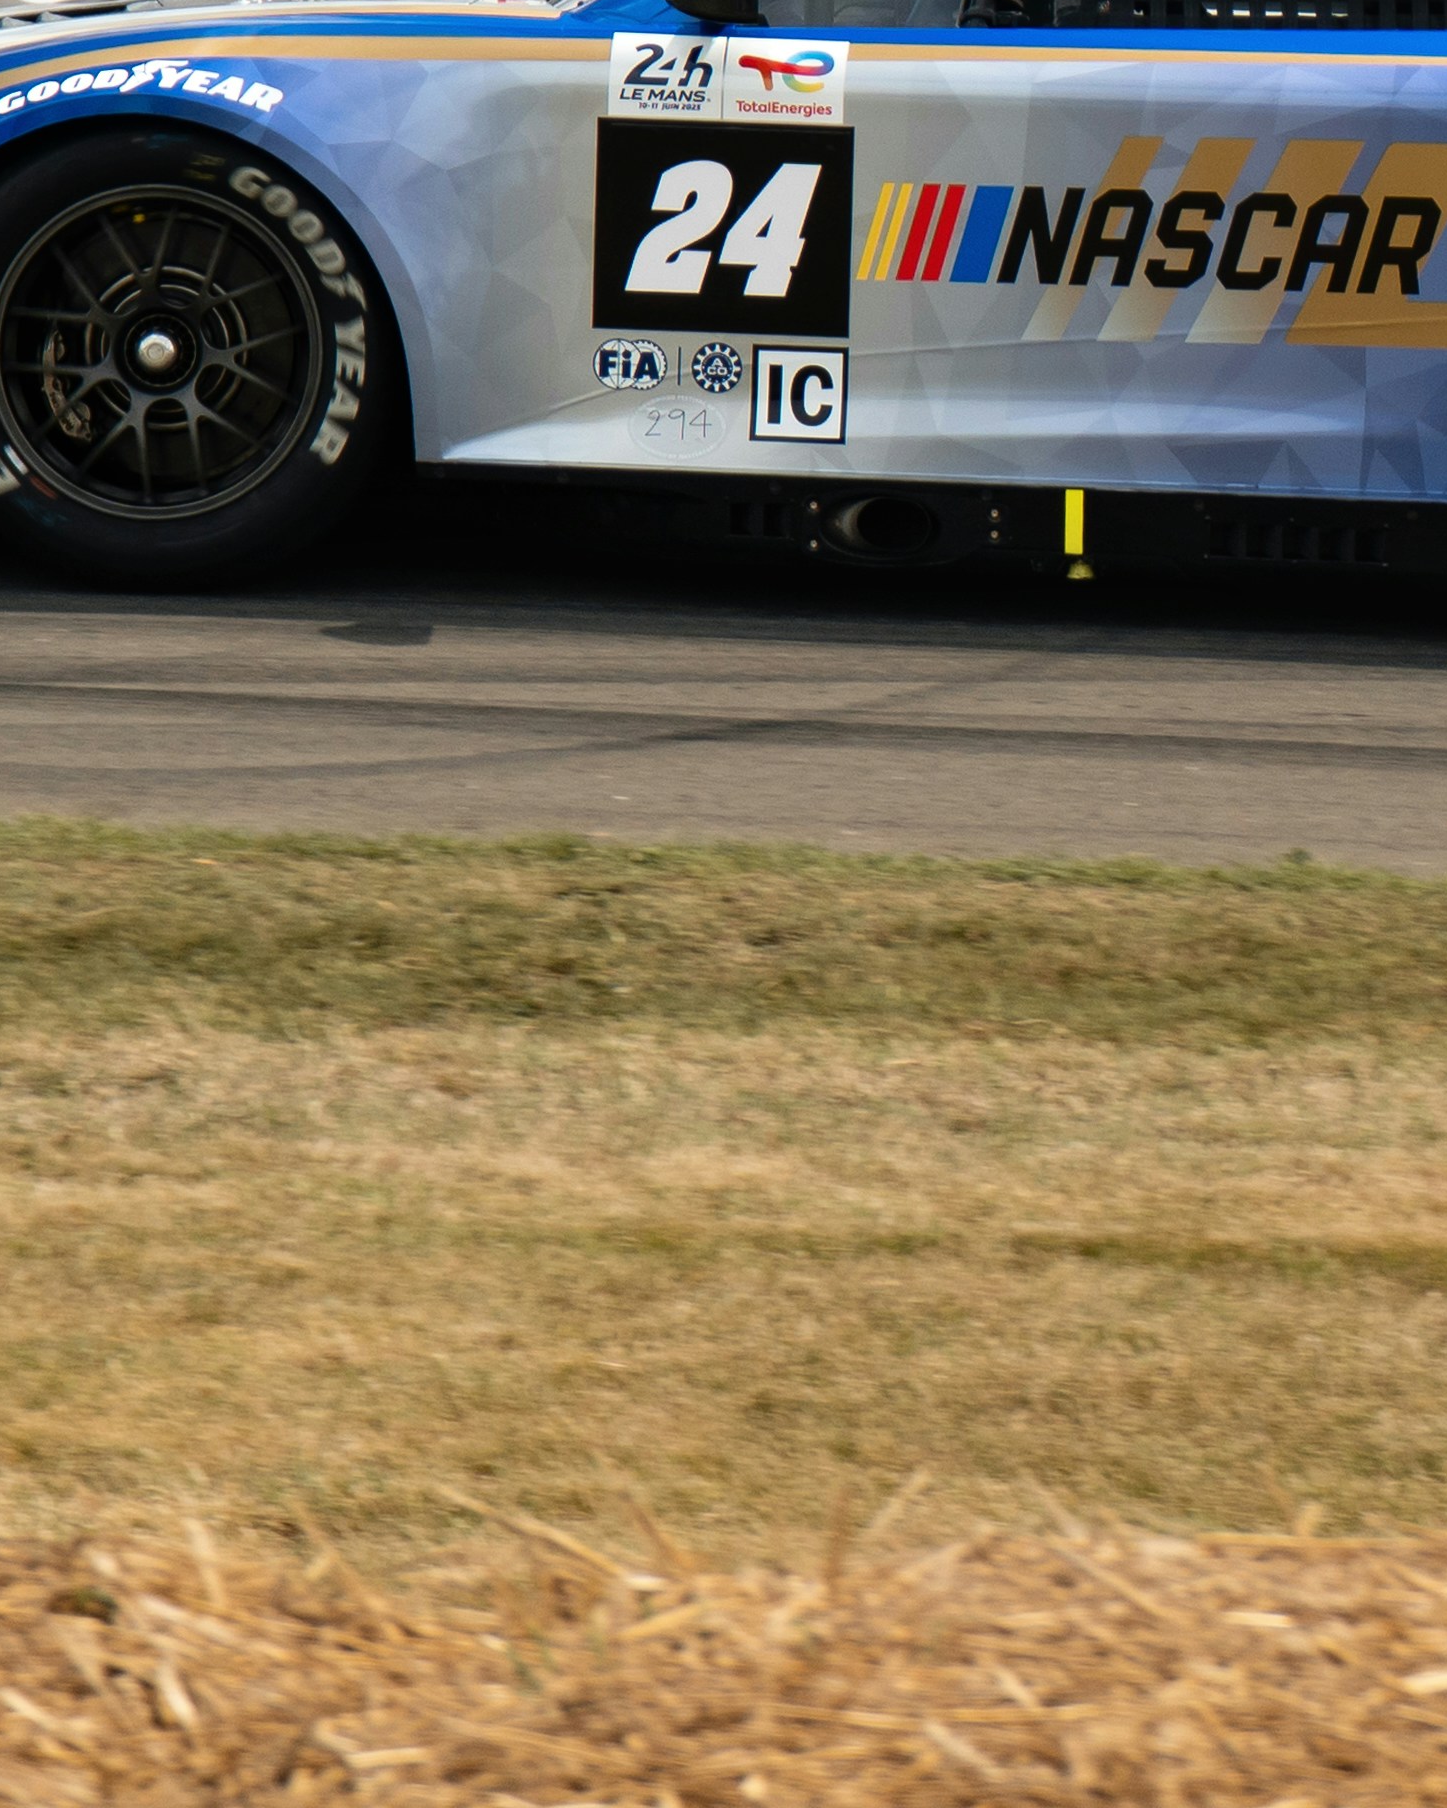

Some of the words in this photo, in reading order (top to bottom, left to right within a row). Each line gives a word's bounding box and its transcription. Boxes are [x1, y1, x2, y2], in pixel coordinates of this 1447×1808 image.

[619, 88, 645, 101] LE
[648, 89, 706, 103] MANS
[735, 100, 833, 118] TotalEnergies
[624, 159, 822, 297] 24
[997, 186, 1441, 295] NASCAR
[766, 364, 834, 428] IC
[644, 408, 712, 440] 294
